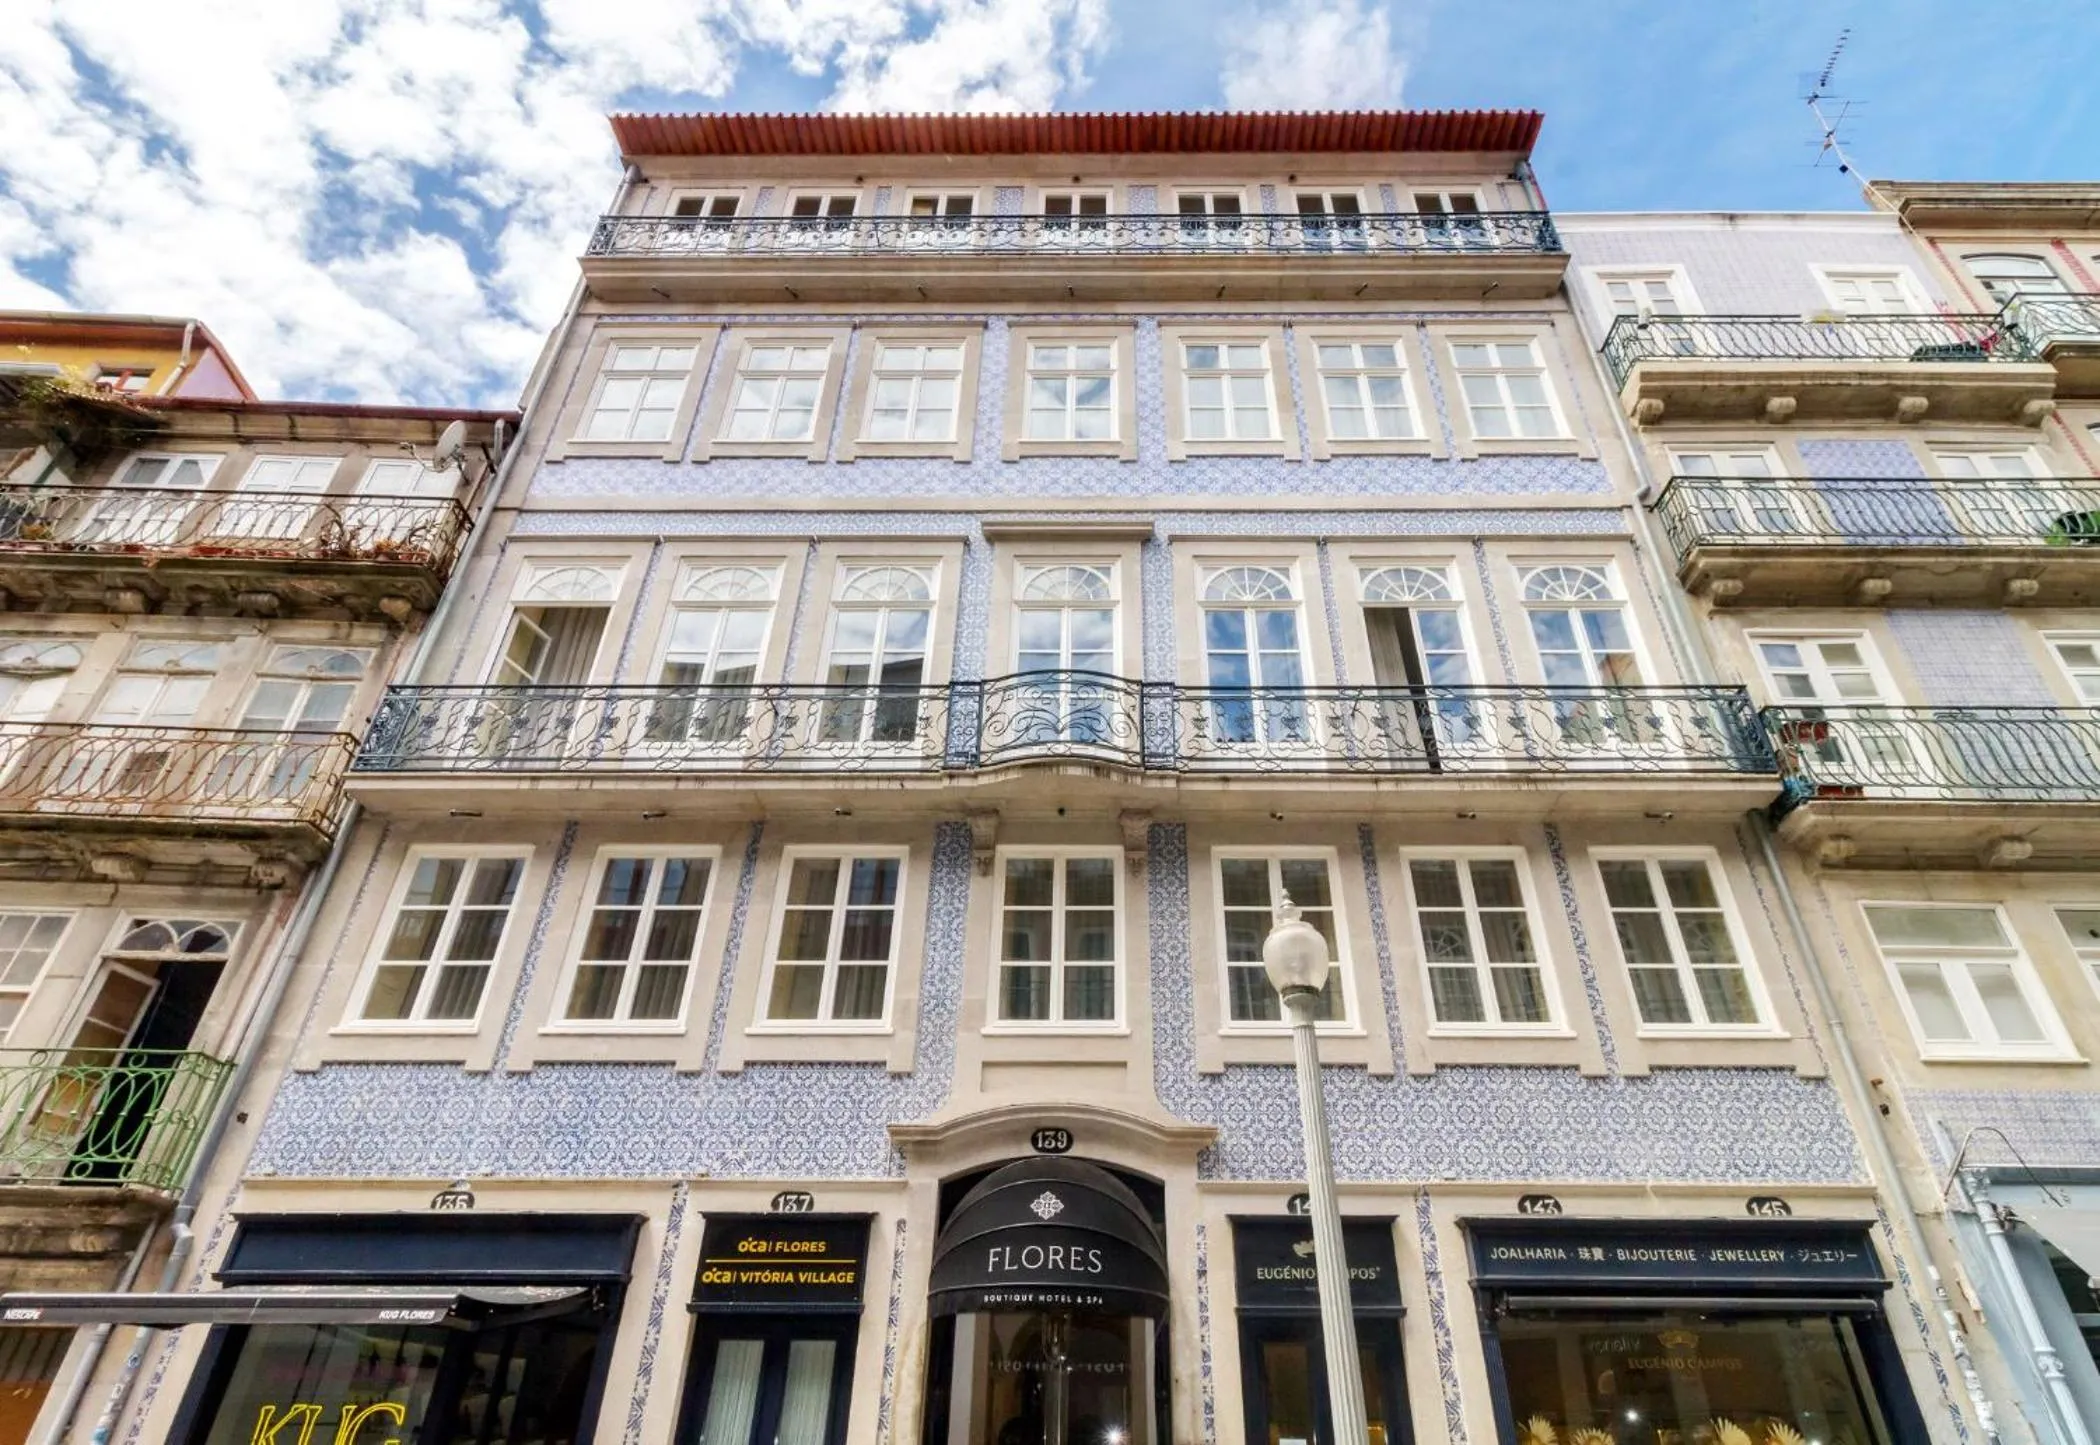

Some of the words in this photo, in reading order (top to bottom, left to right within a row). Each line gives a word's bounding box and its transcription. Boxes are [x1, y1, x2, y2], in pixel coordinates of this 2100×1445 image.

[1036, 1130, 1068, 1149] 139
[778, 1194, 811, 1213] 137
[1523, 1199, 1558, 1215] 143
[1751, 1200, 1787, 1216] 145
[775, 1241, 827, 1253] FLORES
[1490, 1247, 1567, 1260] JOALHARIA
[1616, 1248, 1697, 1261] BIJOUTERIE
[1709, 1249, 1785, 1262] JEWELLERY
[1798, 1249, 1858, 1263] ジュエリー
[987, 1245, 1103, 1273] FLORES
[740, 1269, 794, 1284] VITÓRIA
[799, 1271, 855, 1284] VILLAGE
[1256, 1265, 1316, 1280] EUGÉNIO
[983, 1294, 1033, 1303] BOUTIQUE
[1038, 1294, 1072, 1303] HOTEL
[1086, 1295, 1103, 1305] SPA
[379, 1309, 400, 1320] KUG
[400, 1309, 436, 1320] FLORES
